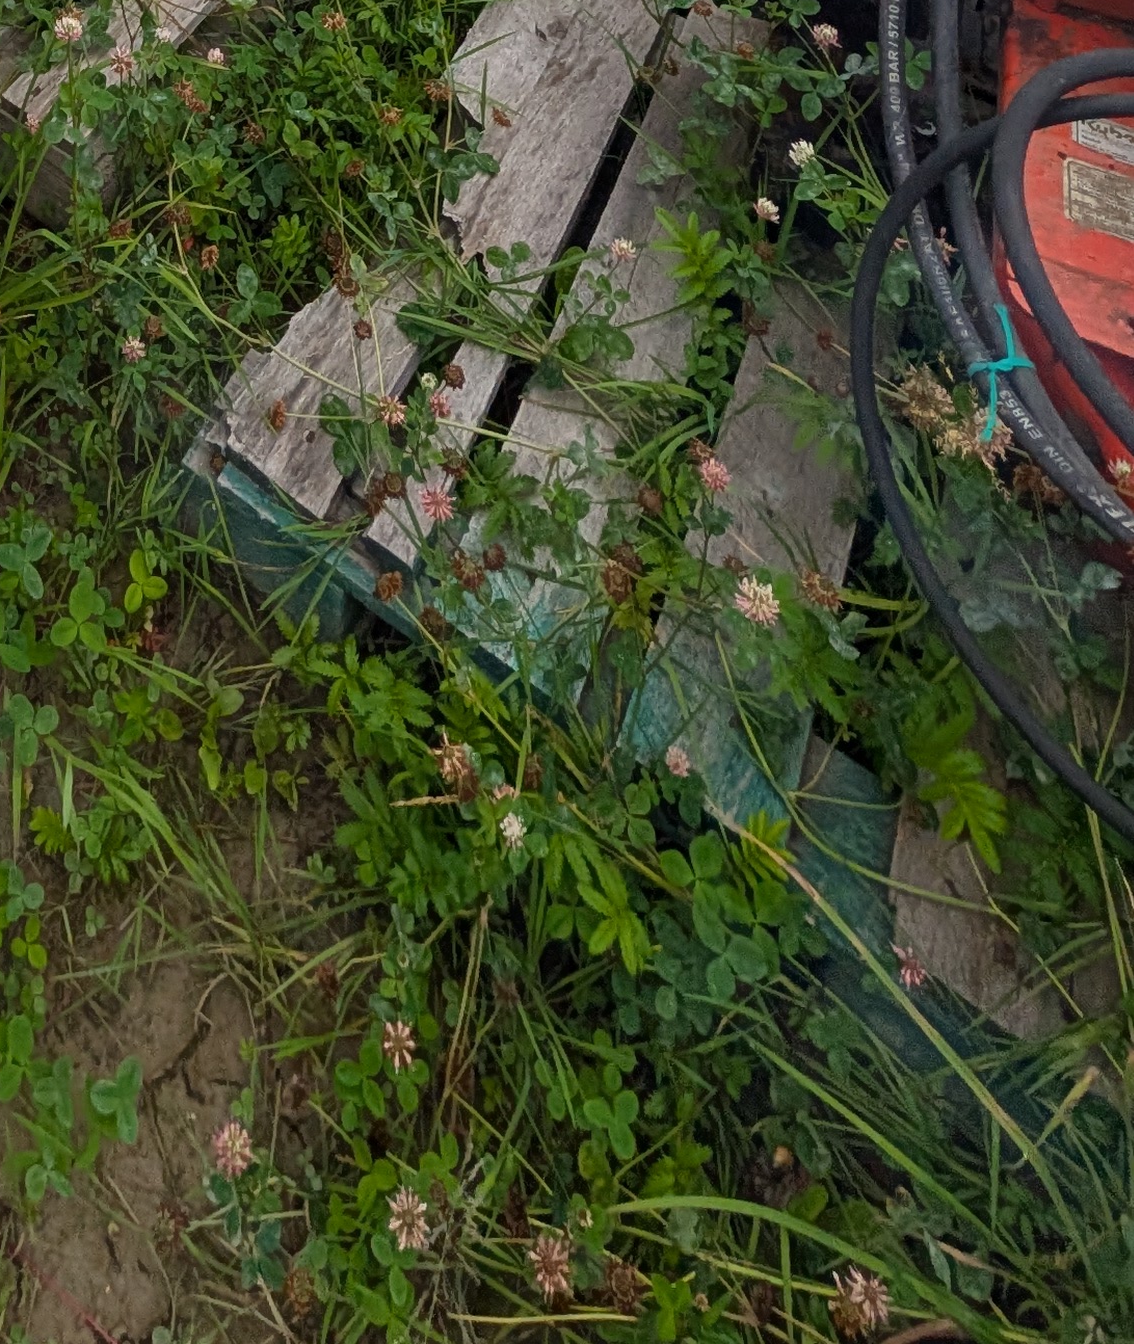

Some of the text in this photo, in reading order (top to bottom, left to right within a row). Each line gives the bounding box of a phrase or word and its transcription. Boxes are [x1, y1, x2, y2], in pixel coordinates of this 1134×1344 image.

[887, 4, 900, 39] 5710
[888, 51, 900, 83] BAR
[1043, 446, 1074, 473] DIN
